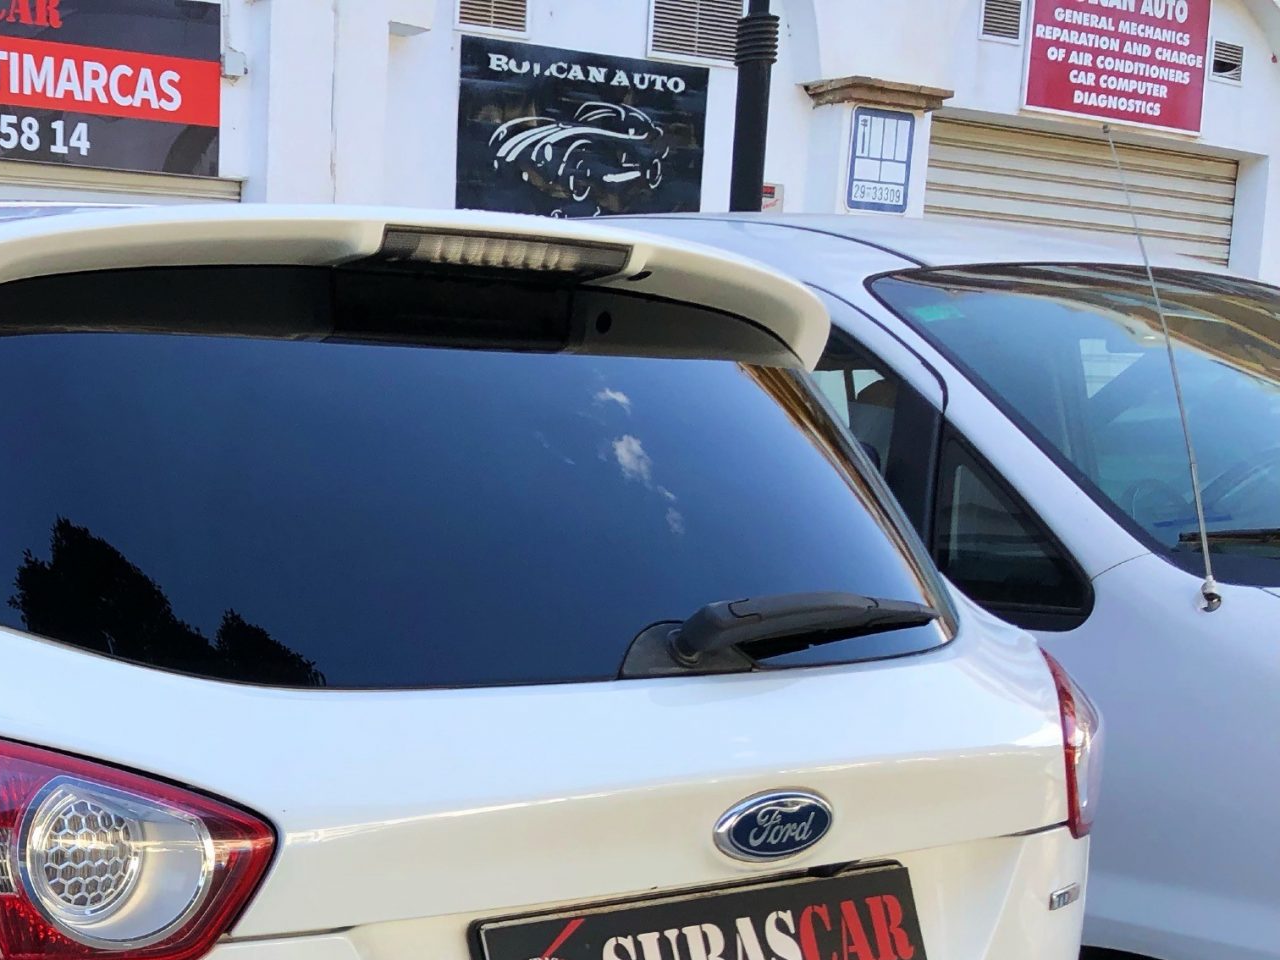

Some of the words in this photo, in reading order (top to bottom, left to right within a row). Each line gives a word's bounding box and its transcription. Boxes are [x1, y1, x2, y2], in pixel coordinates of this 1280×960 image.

[1054, 7, 1115, 31] GENERAL
[1118, 21, 1190, 46] MECHANICS
[1140, 0, 1189, 24] AUTO
[1035, 24, 1120, 52] REPARATION
[1123, 41, 1152, 57] AND
[1155, 47, 1204, 68] CHARGE
[609, 69, 686, 94] AUTO
[1047, 46, 1066, 61] OF
[1068, 50, 1093, 67] AIR
[1096, 55, 1190, 85] CONDITIONERS
[1069, 69, 1096, 86] CAR
[1099, 74, 1168, 98] COMPUTER
[1073, 90, 1161, 117] DIAGNOSTICS
[50, 119, 92, 156] 14
[749, 802, 816, 848] Ford
